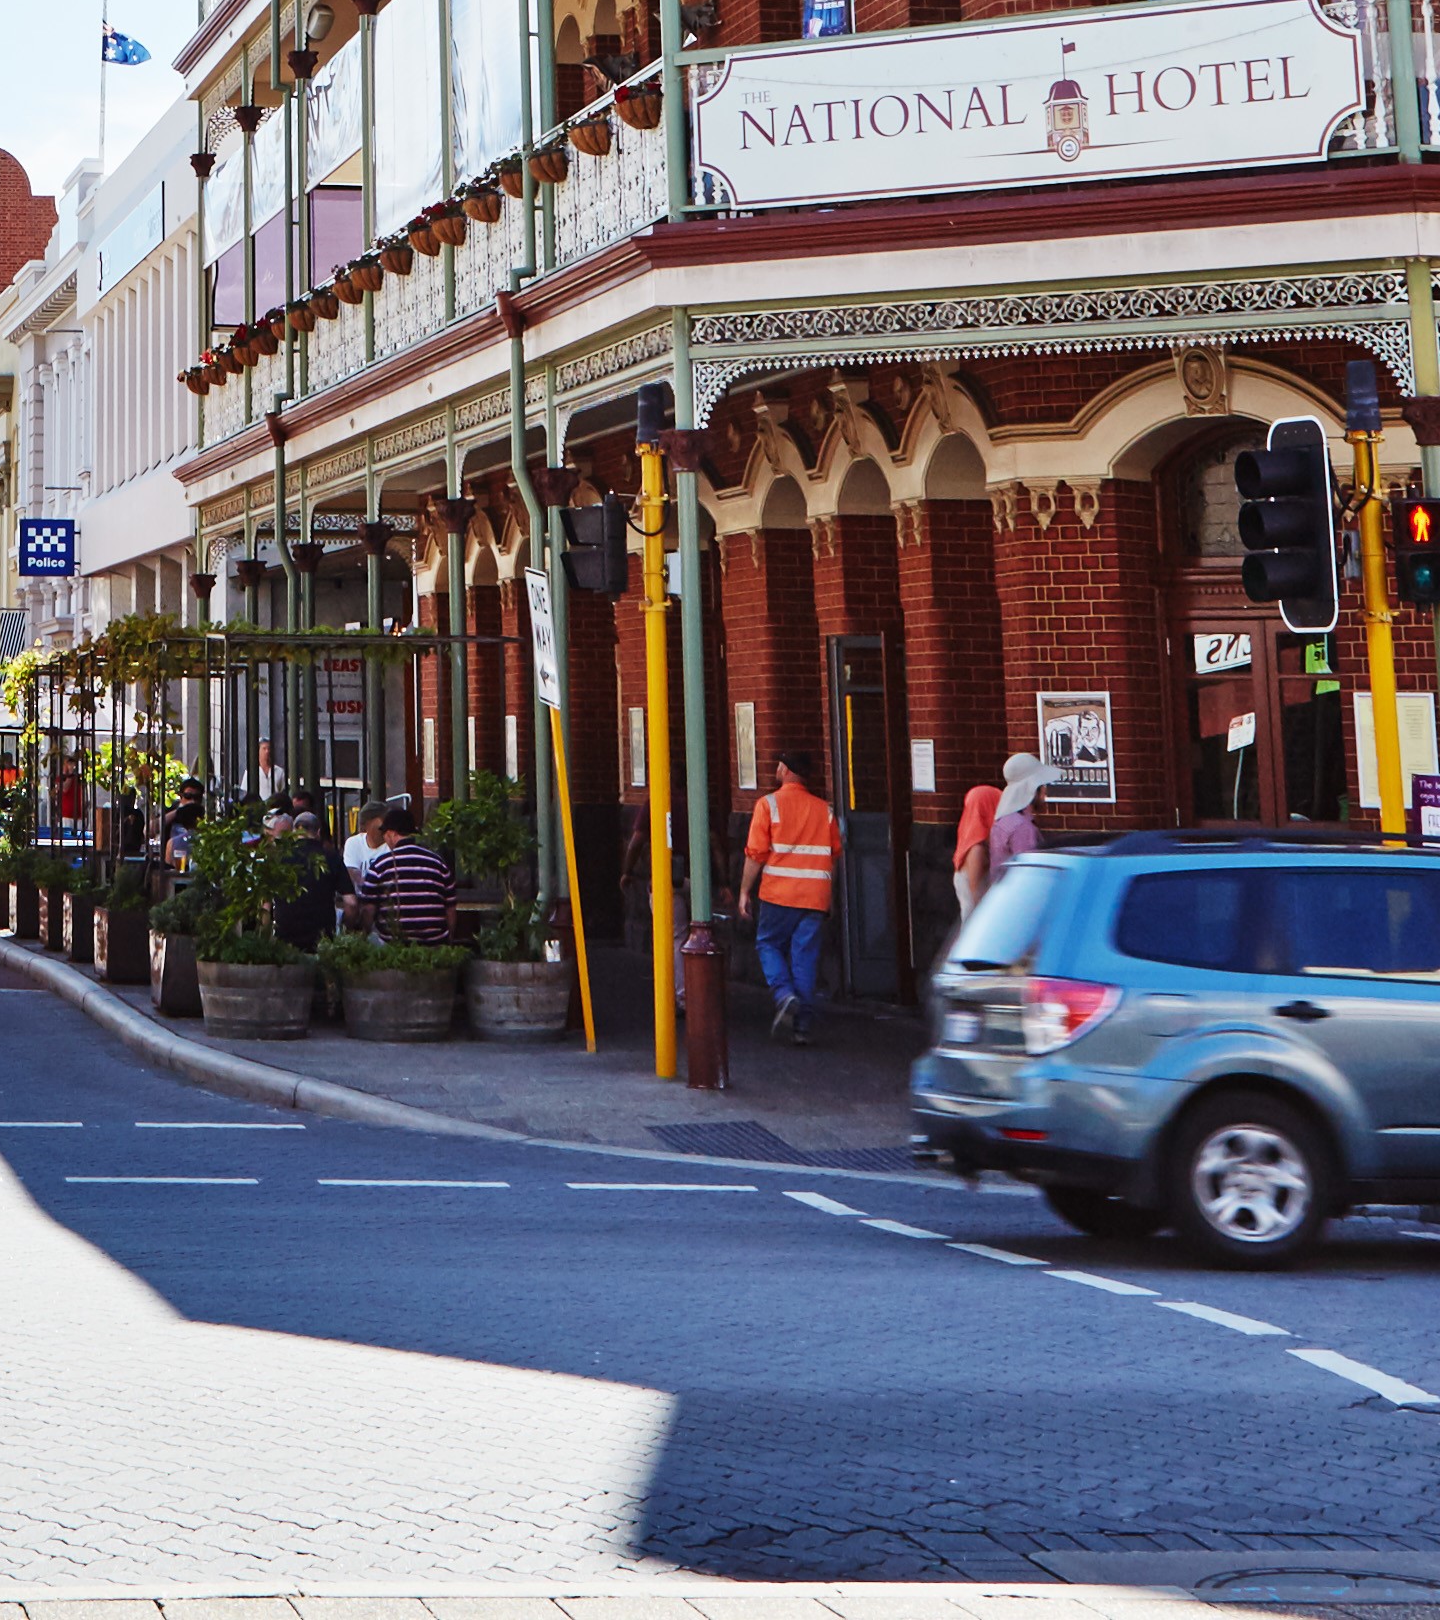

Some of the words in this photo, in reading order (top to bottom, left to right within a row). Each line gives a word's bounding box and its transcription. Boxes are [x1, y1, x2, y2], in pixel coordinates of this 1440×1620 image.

[738, 84, 1028, 151] NATIONAL
[1105, 56, 1313, 118] HOTEL
[741, 90, 772, 106] THE
[27, 557, 67, 569] Police
[531, 583, 548, 615] ONE
[534, 622, 551, 655] WAY
[1419, 780, 1433, 789] The
